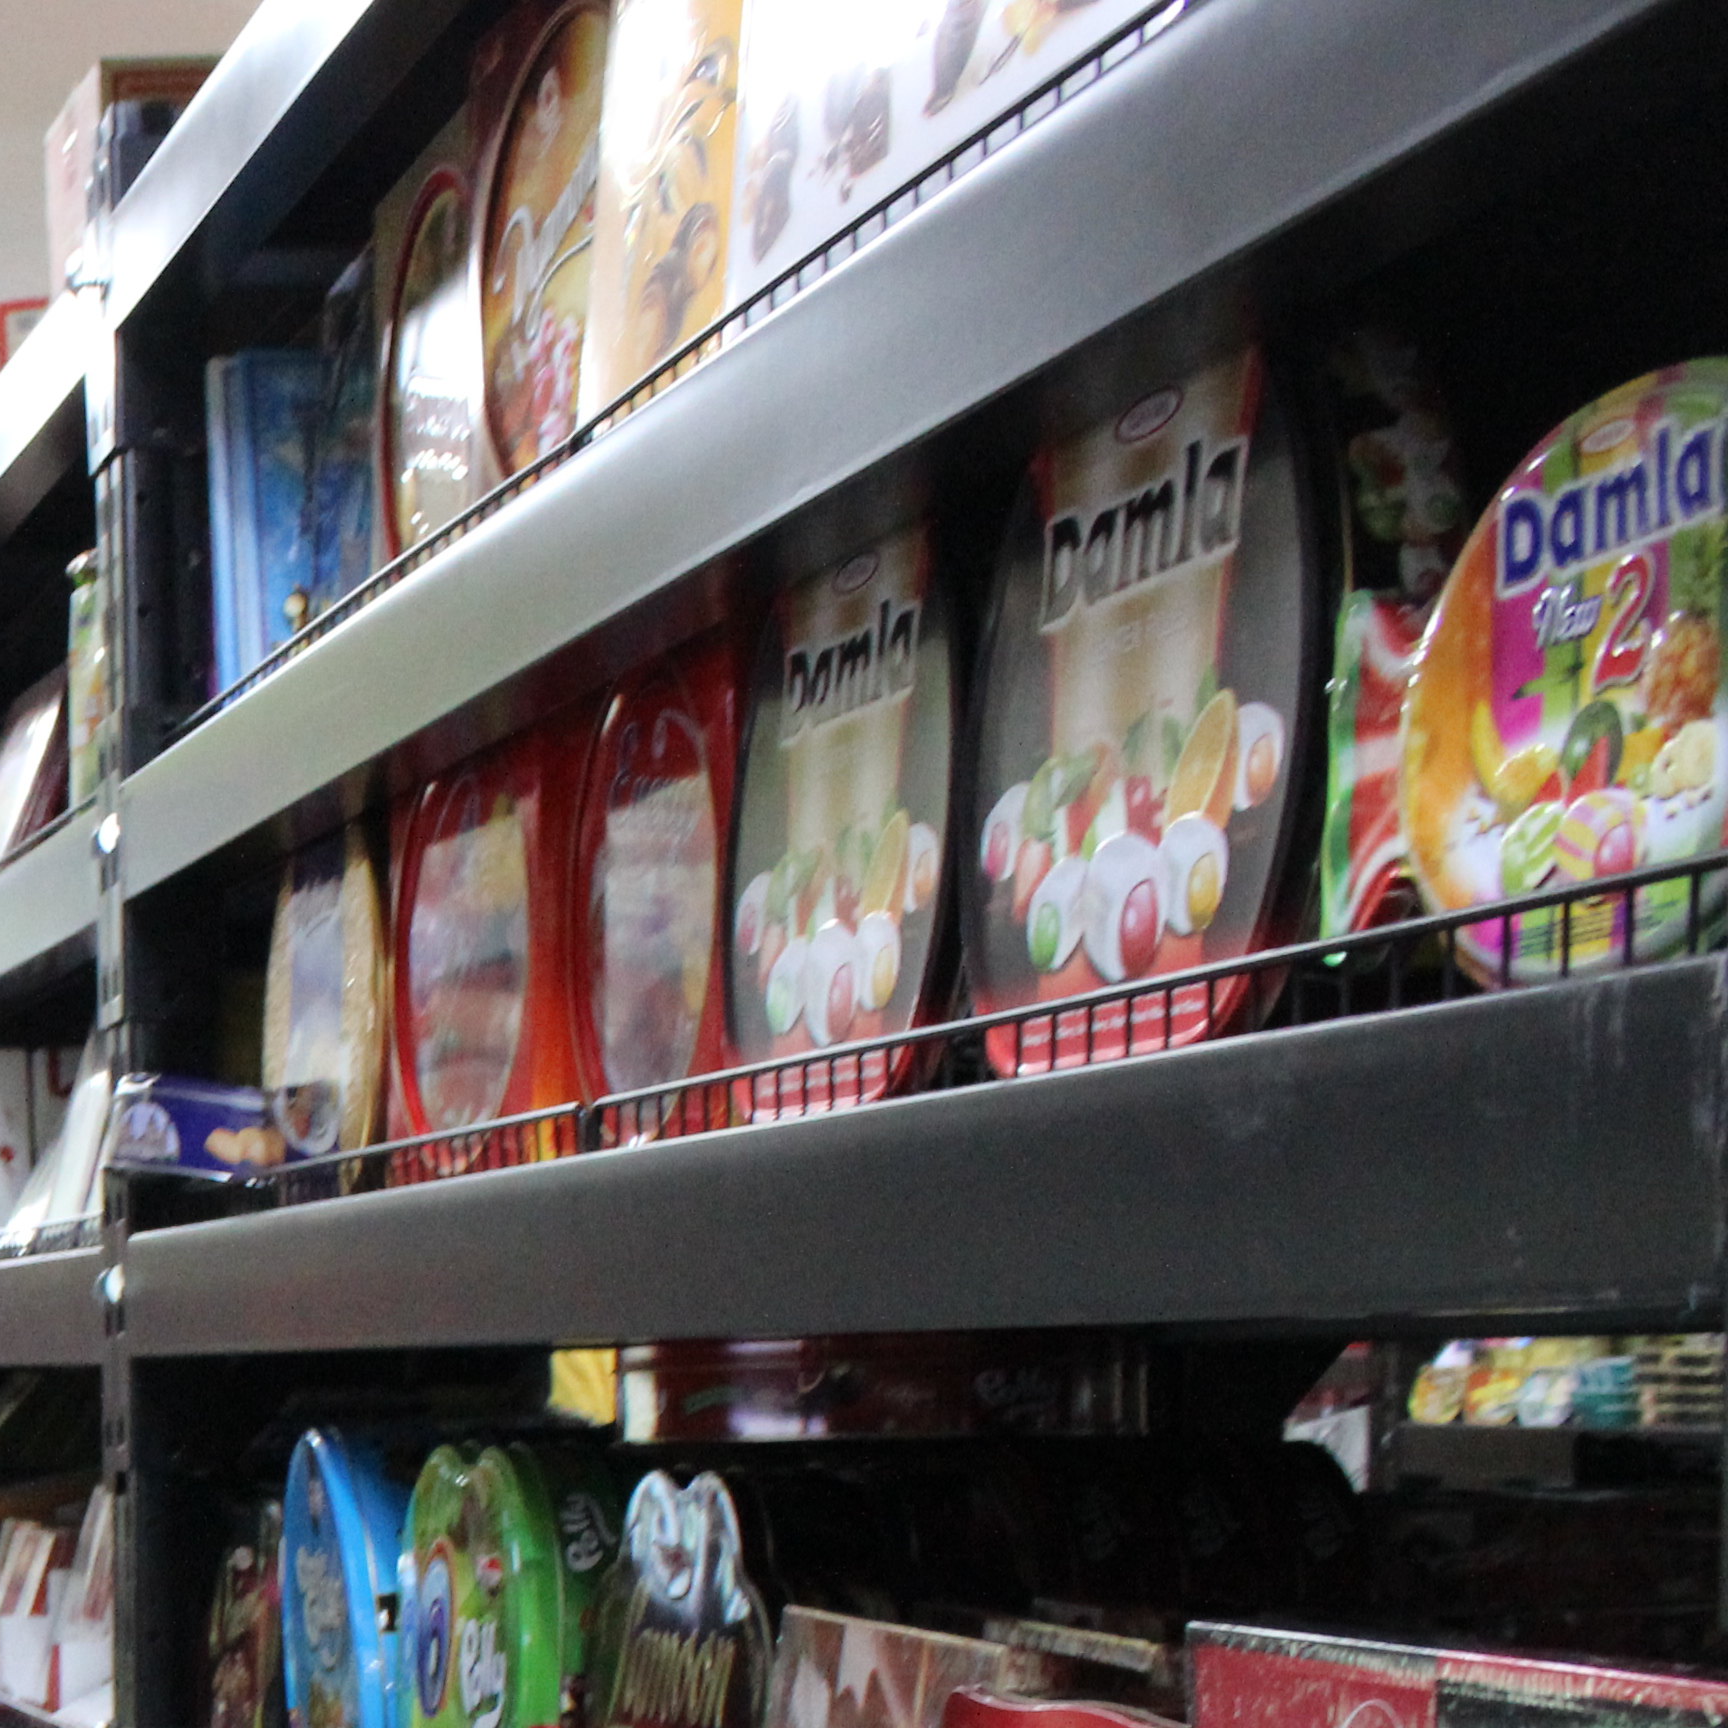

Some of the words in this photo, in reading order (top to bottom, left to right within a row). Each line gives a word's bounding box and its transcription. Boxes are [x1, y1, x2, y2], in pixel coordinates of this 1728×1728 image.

[1041, 436, 1247, 631] Damla
[1496, 415, 1722, 600] Damla
[1593, 547, 1656, 696] 2
